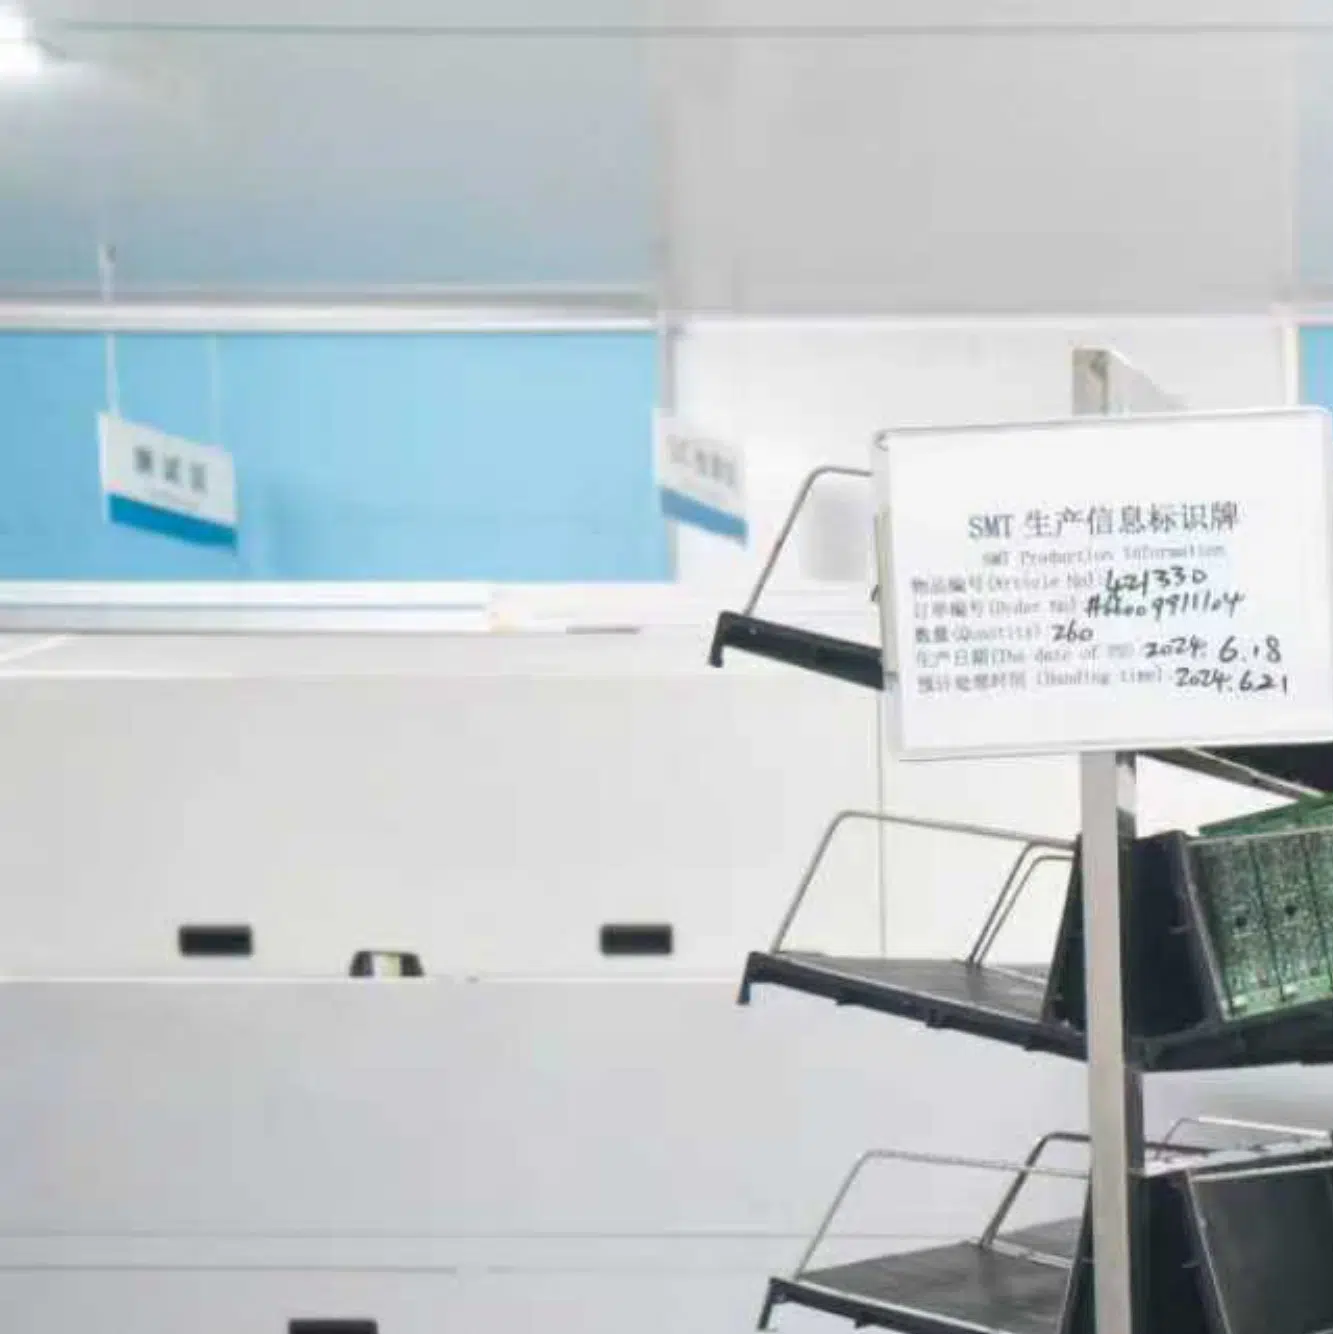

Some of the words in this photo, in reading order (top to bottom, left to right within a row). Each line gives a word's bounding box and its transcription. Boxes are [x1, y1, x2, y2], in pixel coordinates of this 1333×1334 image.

[968, 513, 1014, 539] SMT
[1024, 500, 1238, 538] 生产信息标识牌
[1052, 618, 1096, 643] 260
